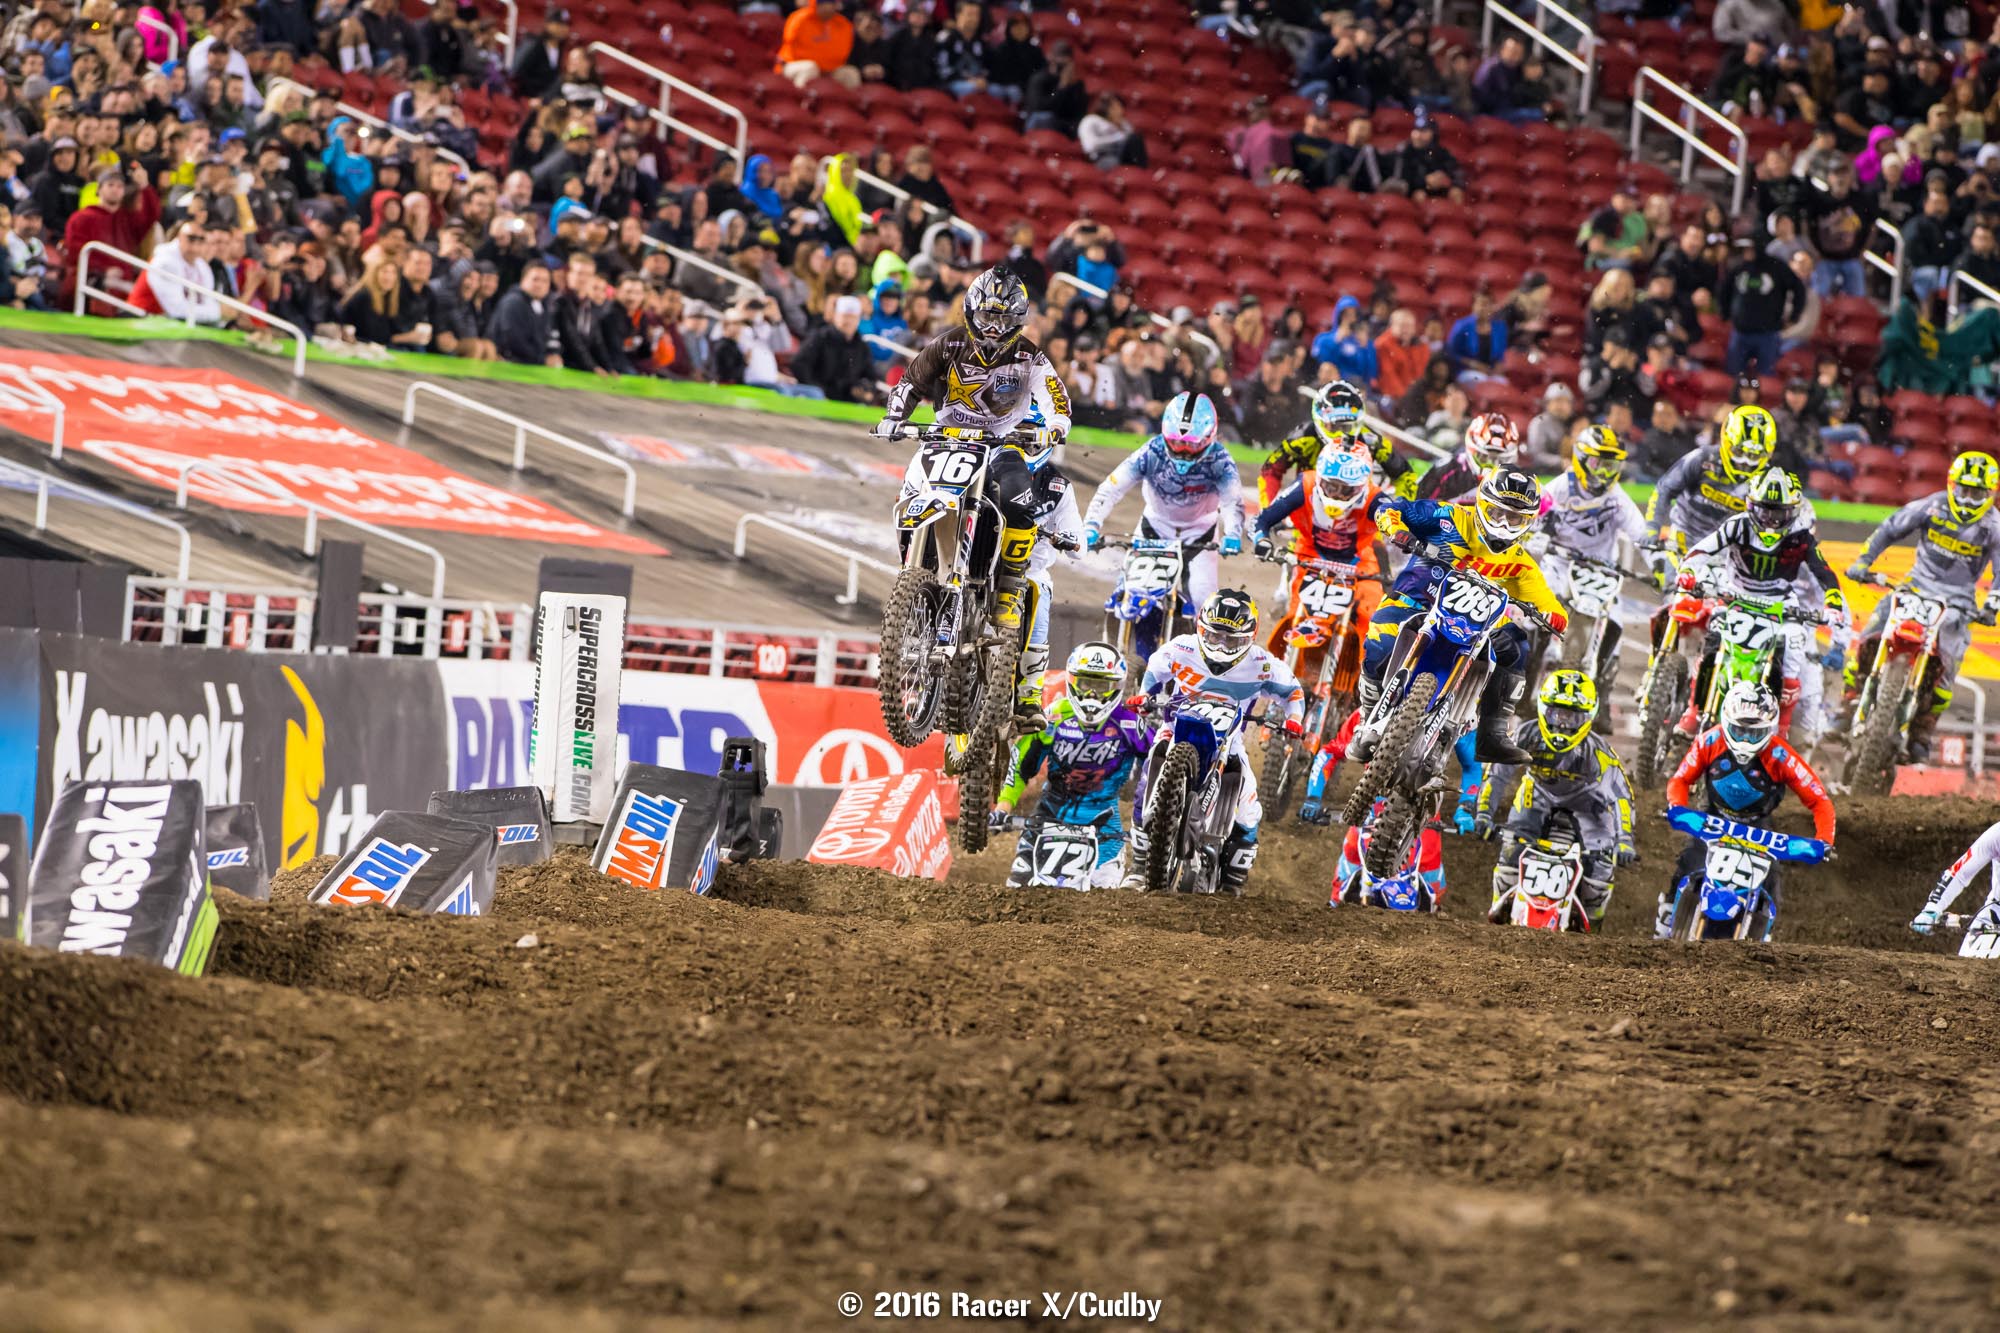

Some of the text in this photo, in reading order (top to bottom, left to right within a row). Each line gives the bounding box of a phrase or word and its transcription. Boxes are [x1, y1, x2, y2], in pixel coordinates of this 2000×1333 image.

[928, 451, 978, 483] 16
[1126, 556, 1178, 587] 92
[1574, 567, 1618, 600] 222
[1299, 579, 1353, 615] 42
[1441, 580, 1501, 622] 289
[1724, 609, 1776, 650] 37
[757, 645, 787, 674] 120
[570, 606, 602, 817] SUPERCROSSLIVE.COM
[54, 670, 244, 806] Kawasaki
[824, 776, 891, 831] TOYOTA
[1703, 814, 1790, 852] BLUE
[59, 784, 172, 957] wasaki
[207, 847, 249, 868] OIL
[327, 842, 425, 908] SOIL
[1042, 841, 1095, 877] 72
[1706, 847, 1771, 890] 85
[1522, 857, 1575, 900] 58
